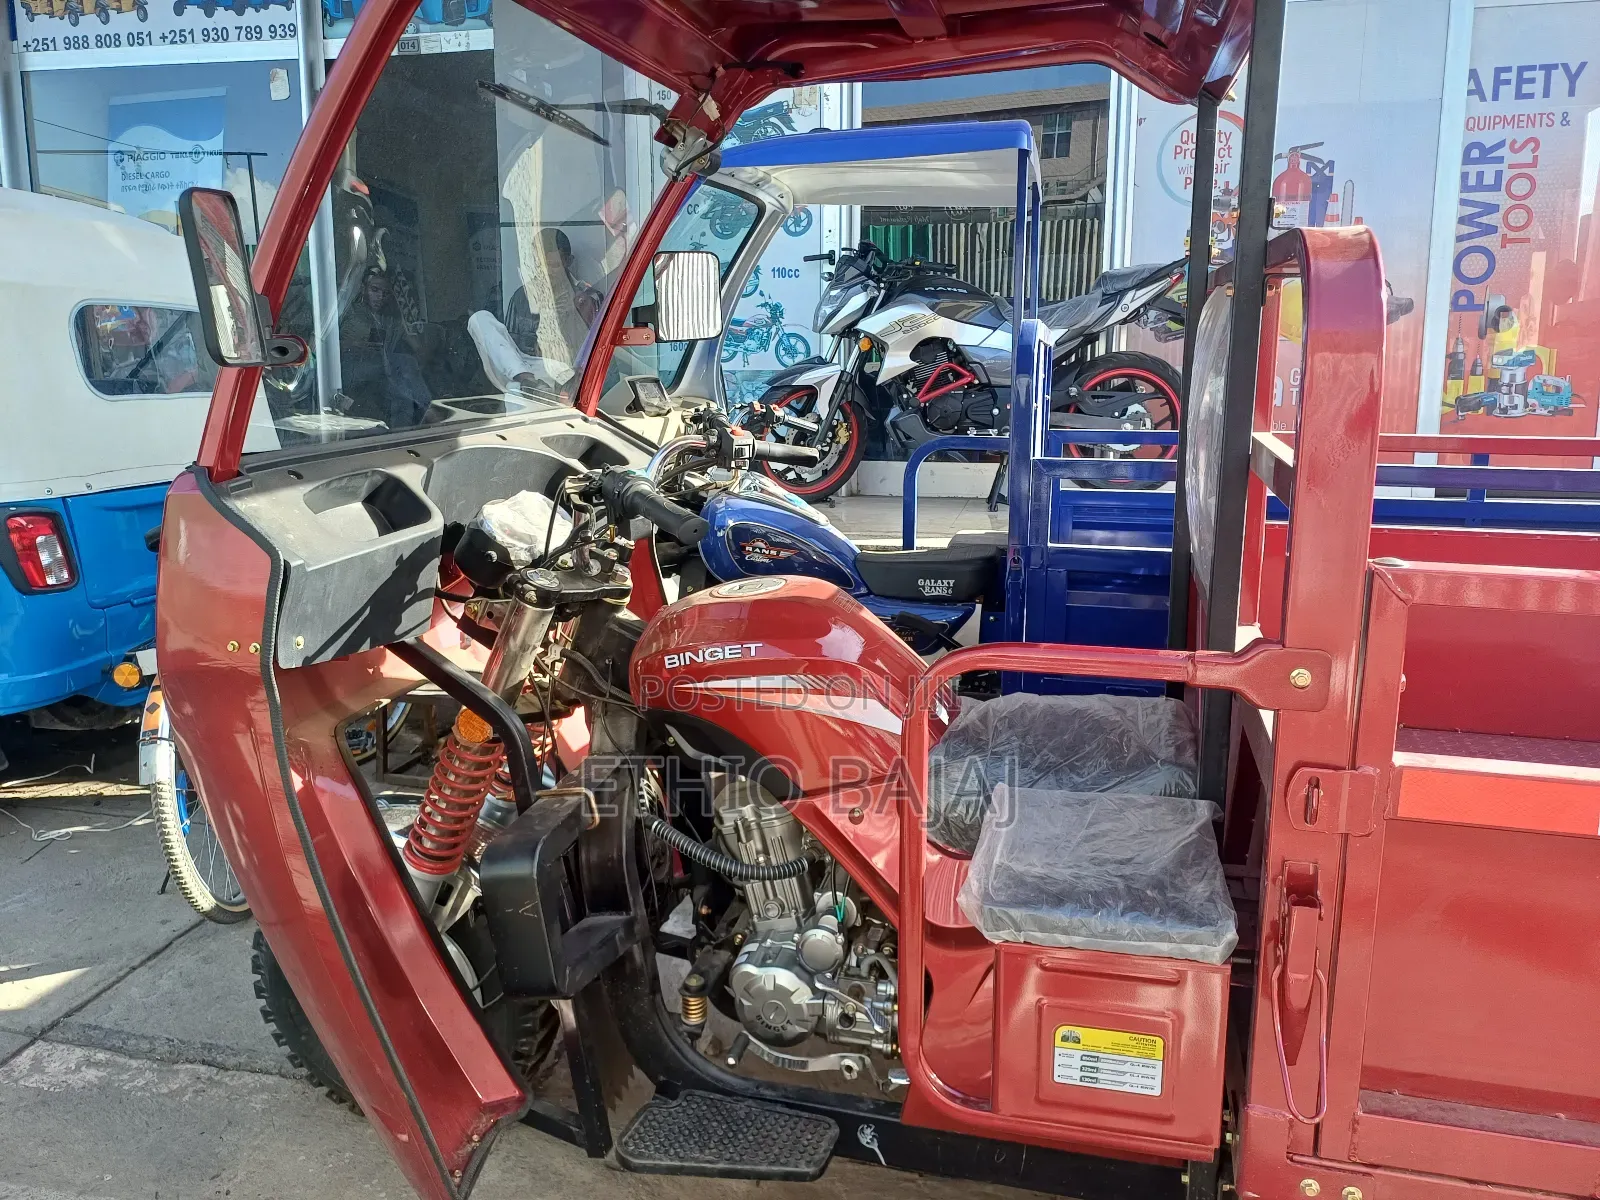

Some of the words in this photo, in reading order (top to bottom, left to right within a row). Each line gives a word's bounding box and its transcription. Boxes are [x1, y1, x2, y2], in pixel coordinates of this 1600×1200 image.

[23, 36, 58, 52] +251
[63, 35, 90, 50] 988
[95, 33, 121, 48] 808
[127, 31, 153, 47] 051
[159, 28, 195, 44] +251
[201, 27, 230, 43] 930
[235, 25, 263, 41] 789
[268, 23, 297, 40] 939
[1467, 61, 1589, 103] AFETY
[1465, 112, 1556, 133] QUIPMENTS
[1560, 111, 1571, 127] &
[1180, 129, 1233, 147] Quty
[127, 152, 167, 163] PIAGGIO
[1173, 144, 1233, 160] Proct
[145, 170, 171, 180] CARGO
[1178, 164, 1194, 175] wit
[1214, 160, 1230, 174] air
[1184, 177, 1221, 190] Pe.
[1500, 136, 1541, 249] TOOLS
[1451, 138, 1507, 312] POWER
[771, 266, 800, 279] 110cc
[917, 578, 956, 587] GALAXY
[663, 642, 763, 669] BINGET
[756, 1014, 793, 1033] BINGET
